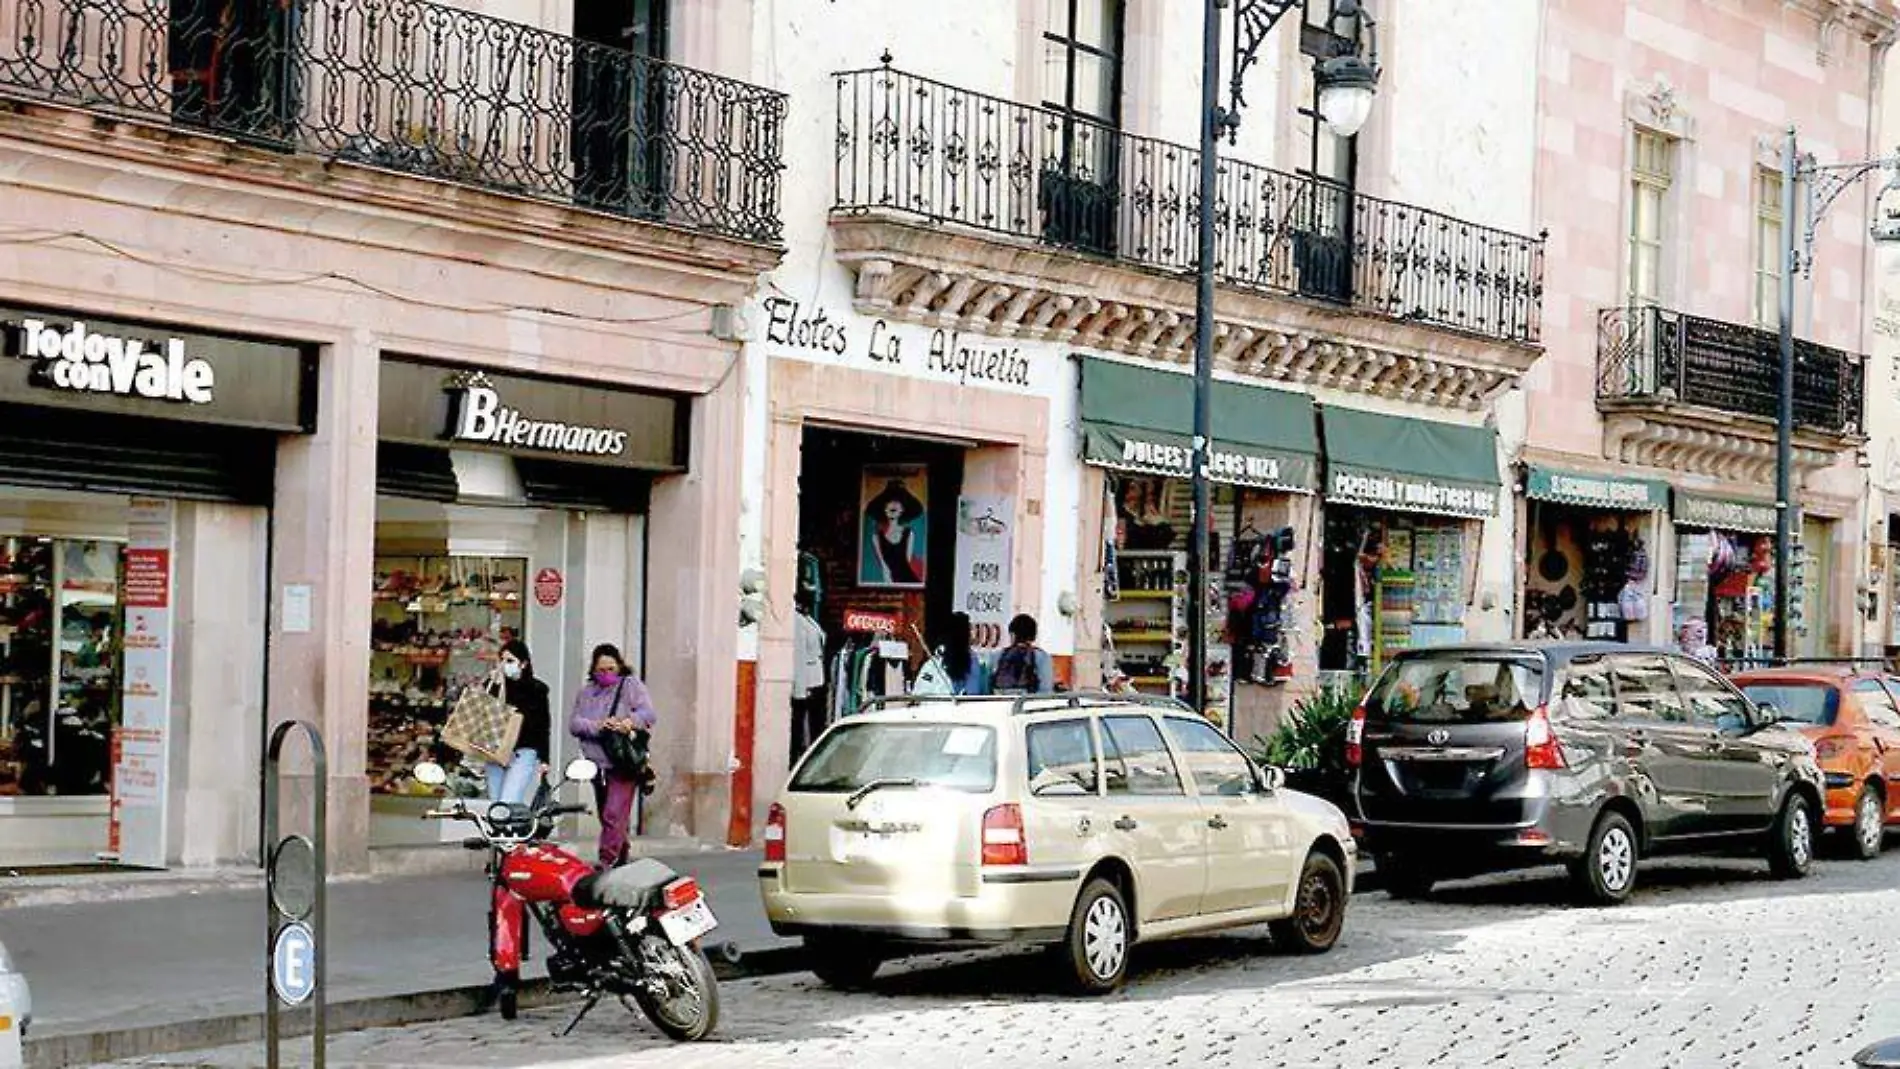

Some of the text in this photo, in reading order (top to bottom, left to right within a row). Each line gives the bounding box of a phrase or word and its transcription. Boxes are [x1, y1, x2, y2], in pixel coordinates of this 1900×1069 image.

[22, 318, 107, 360] Todo
[763, 297, 847, 355] Elotes
[868, 319, 901, 363] La
[53, 337, 214, 402] con Vale
[1123, 439, 1182, 467] DULCES
[285, 940, 305, 988] E
